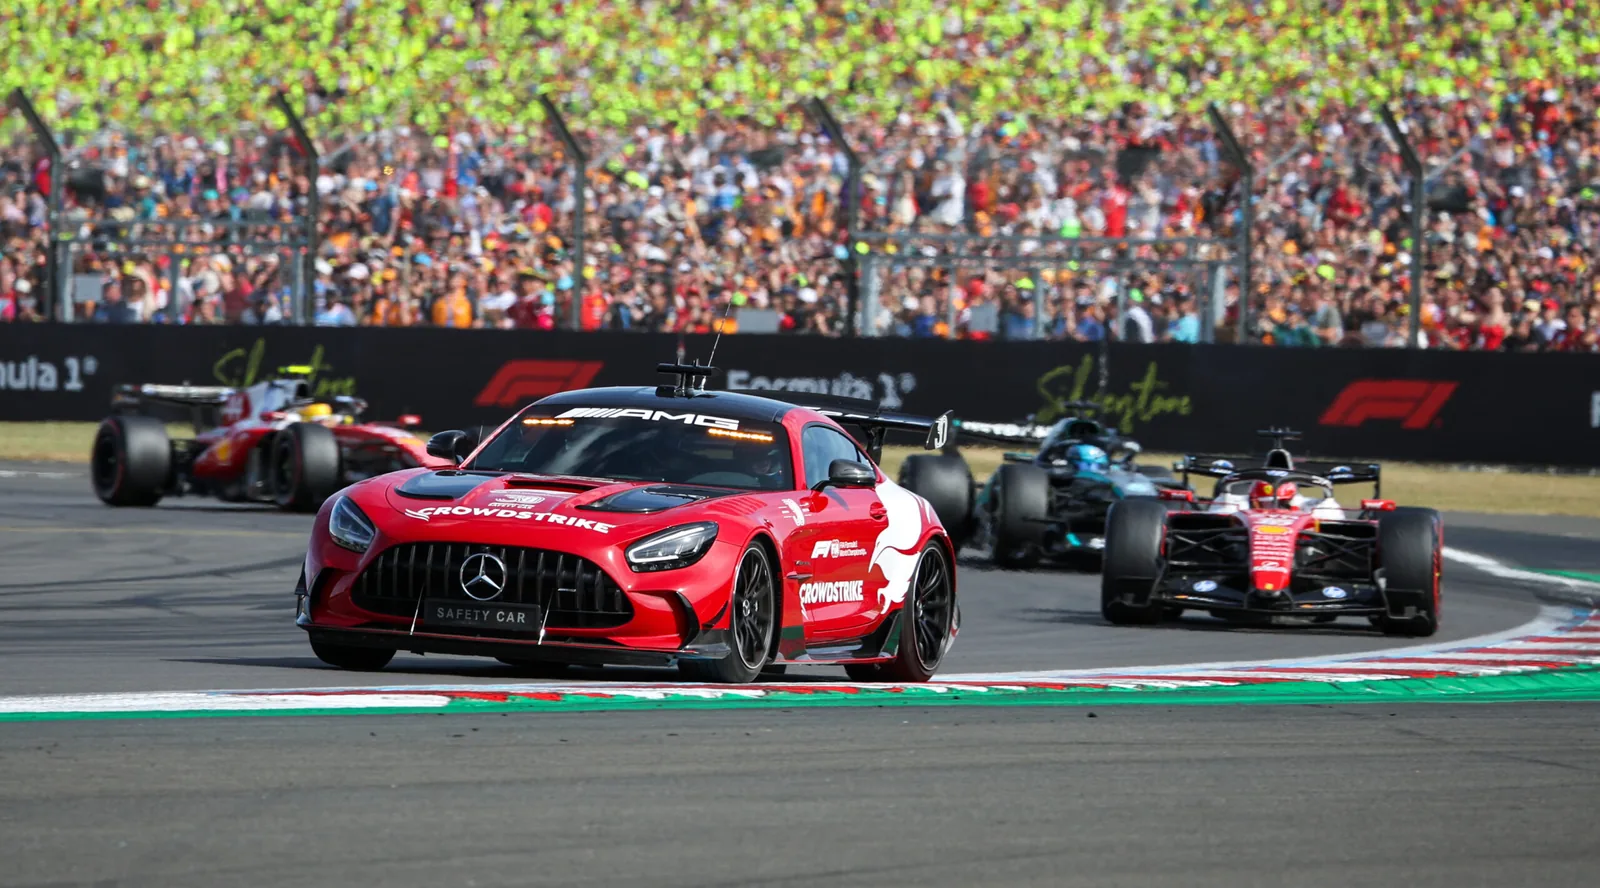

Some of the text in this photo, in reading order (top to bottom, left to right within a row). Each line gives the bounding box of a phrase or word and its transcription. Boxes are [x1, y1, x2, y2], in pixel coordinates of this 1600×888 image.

[1317, 379, 1460, 429] F1
[609, 408, 740, 431] AMG
[418, 506, 617, 534] CROWDSTRIKE
[799, 580, 864, 604] CROWDSTRIKE
[436, 607, 526, 623] SAFETY CAR
